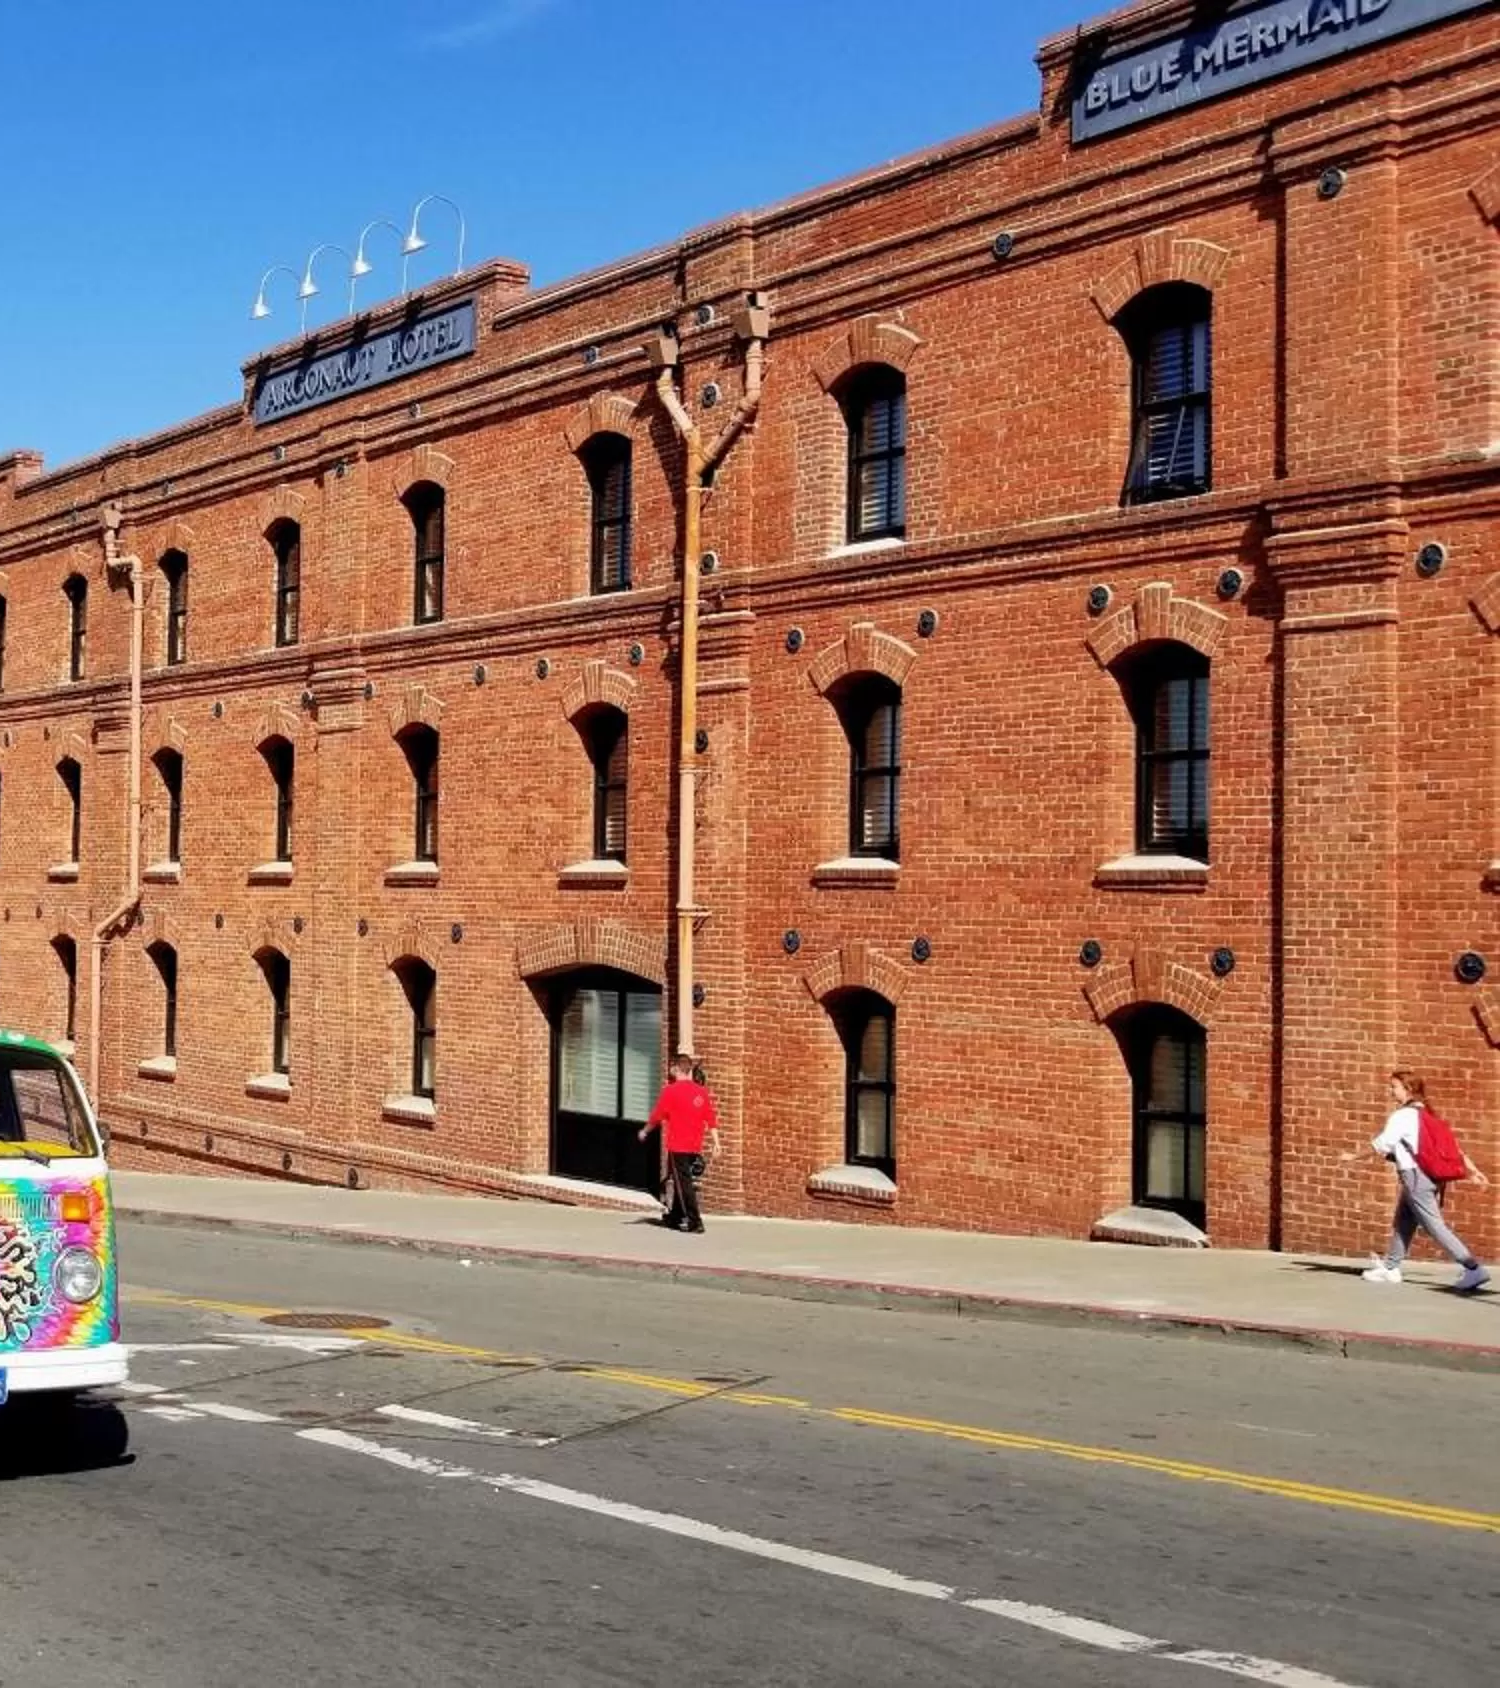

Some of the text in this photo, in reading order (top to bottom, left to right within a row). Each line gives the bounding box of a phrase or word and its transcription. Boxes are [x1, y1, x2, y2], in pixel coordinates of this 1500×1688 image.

[1087, 55, 1184, 111] BLUE
[265, 316, 463, 410] ARGONAUT HOTEL
